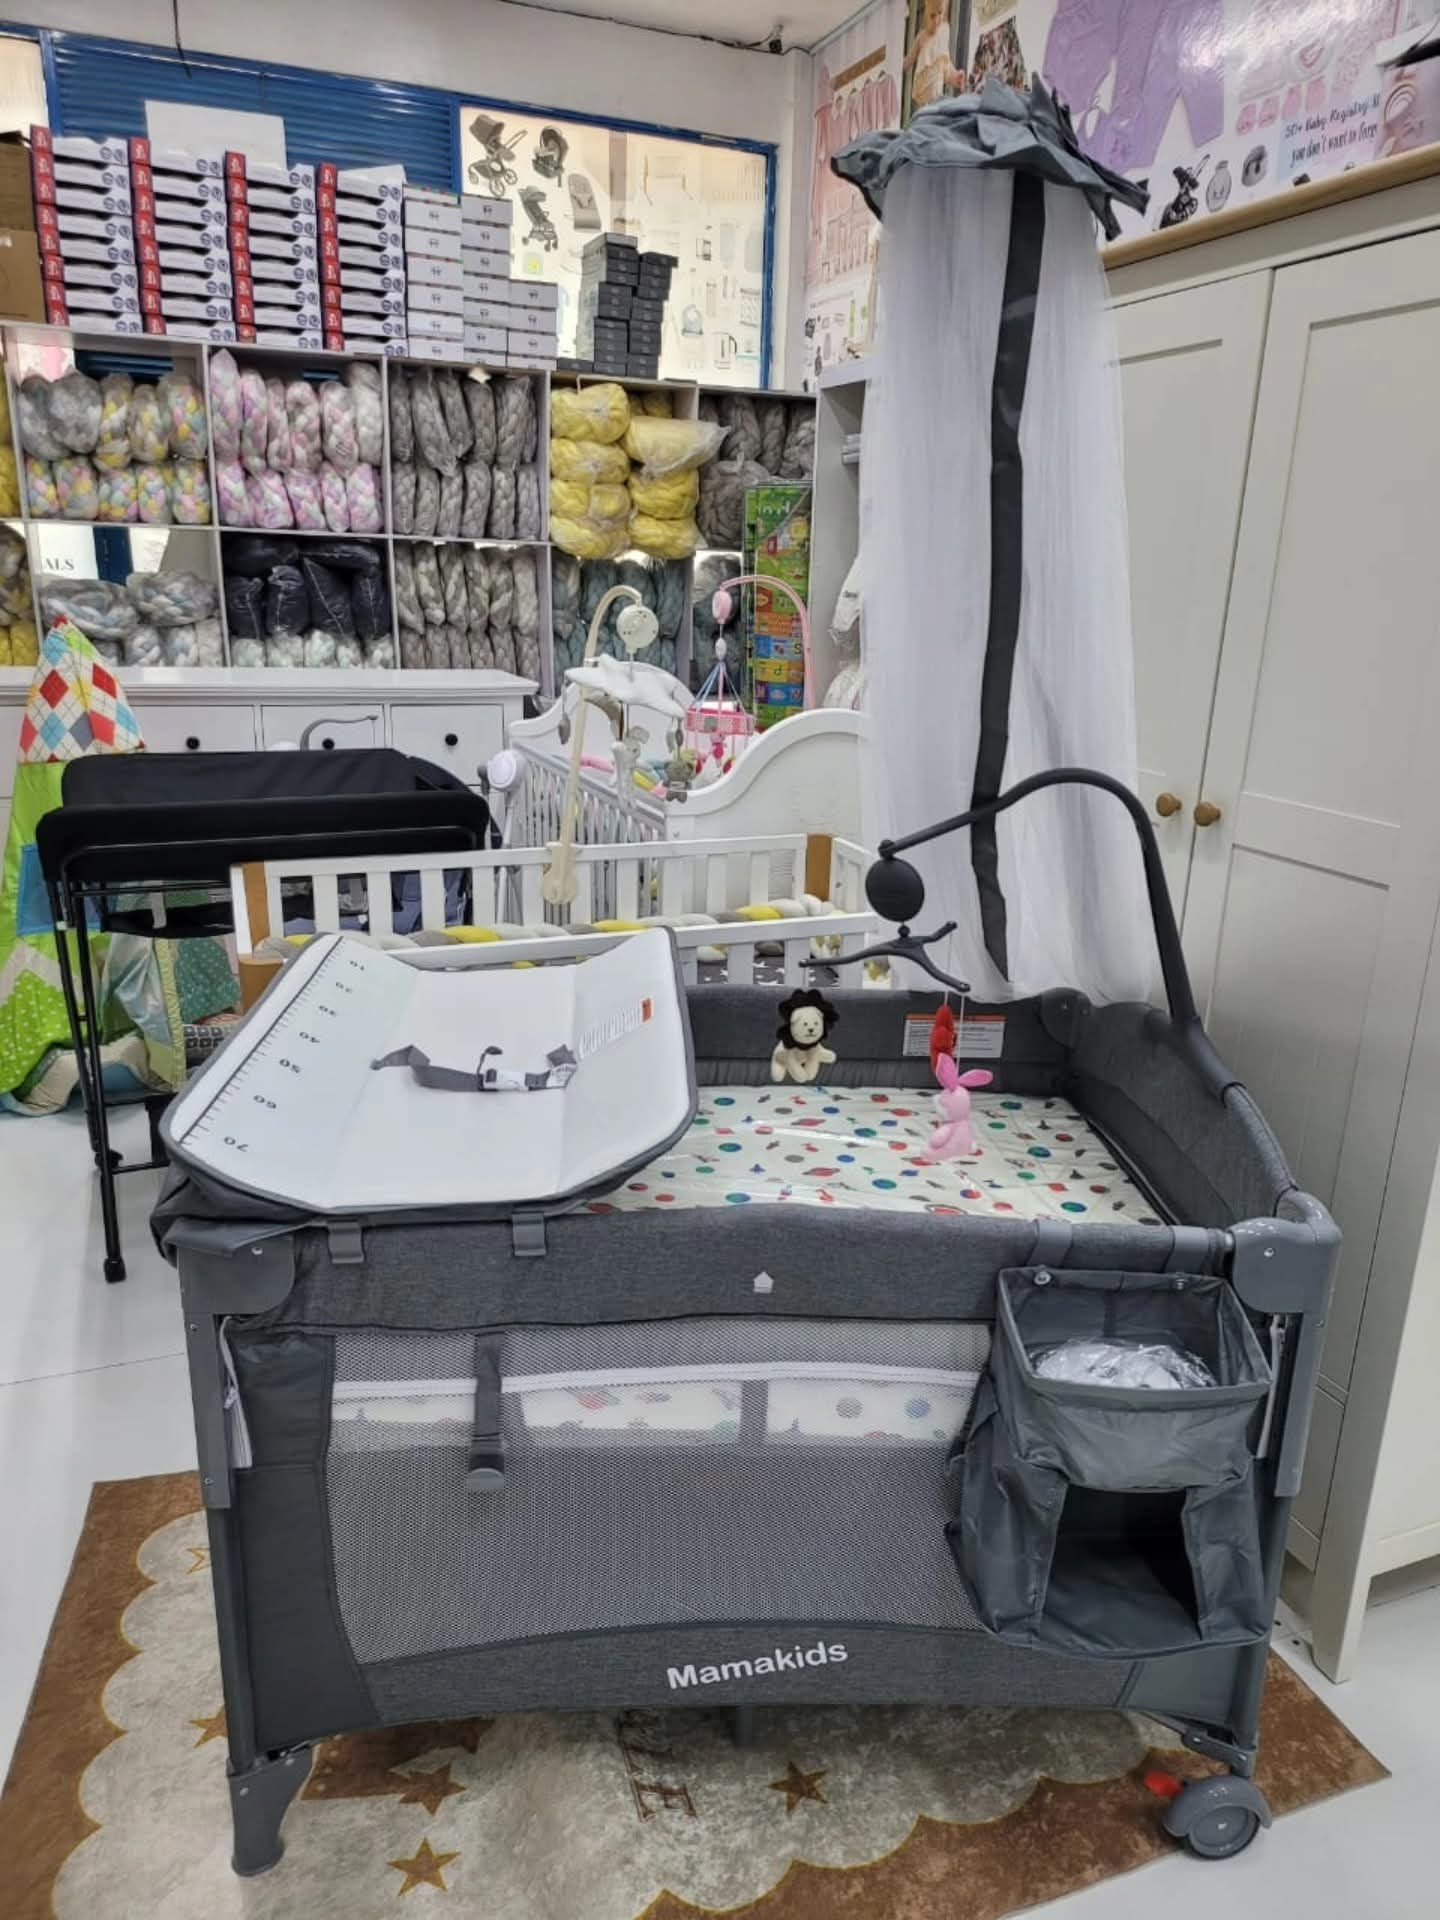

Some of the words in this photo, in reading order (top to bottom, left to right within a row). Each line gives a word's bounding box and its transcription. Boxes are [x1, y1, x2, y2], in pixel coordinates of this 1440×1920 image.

[1306, 113, 1327, 131] Baby
[349, 959, 365, 971] 10
[299, 1031, 321, 1044] 40
[279, 1058, 301, 1073] 50
[253, 1094, 277, 1109] 60
[223, 1136, 249, 1152] 70
[666, 1640, 849, 1690] Mamakids
